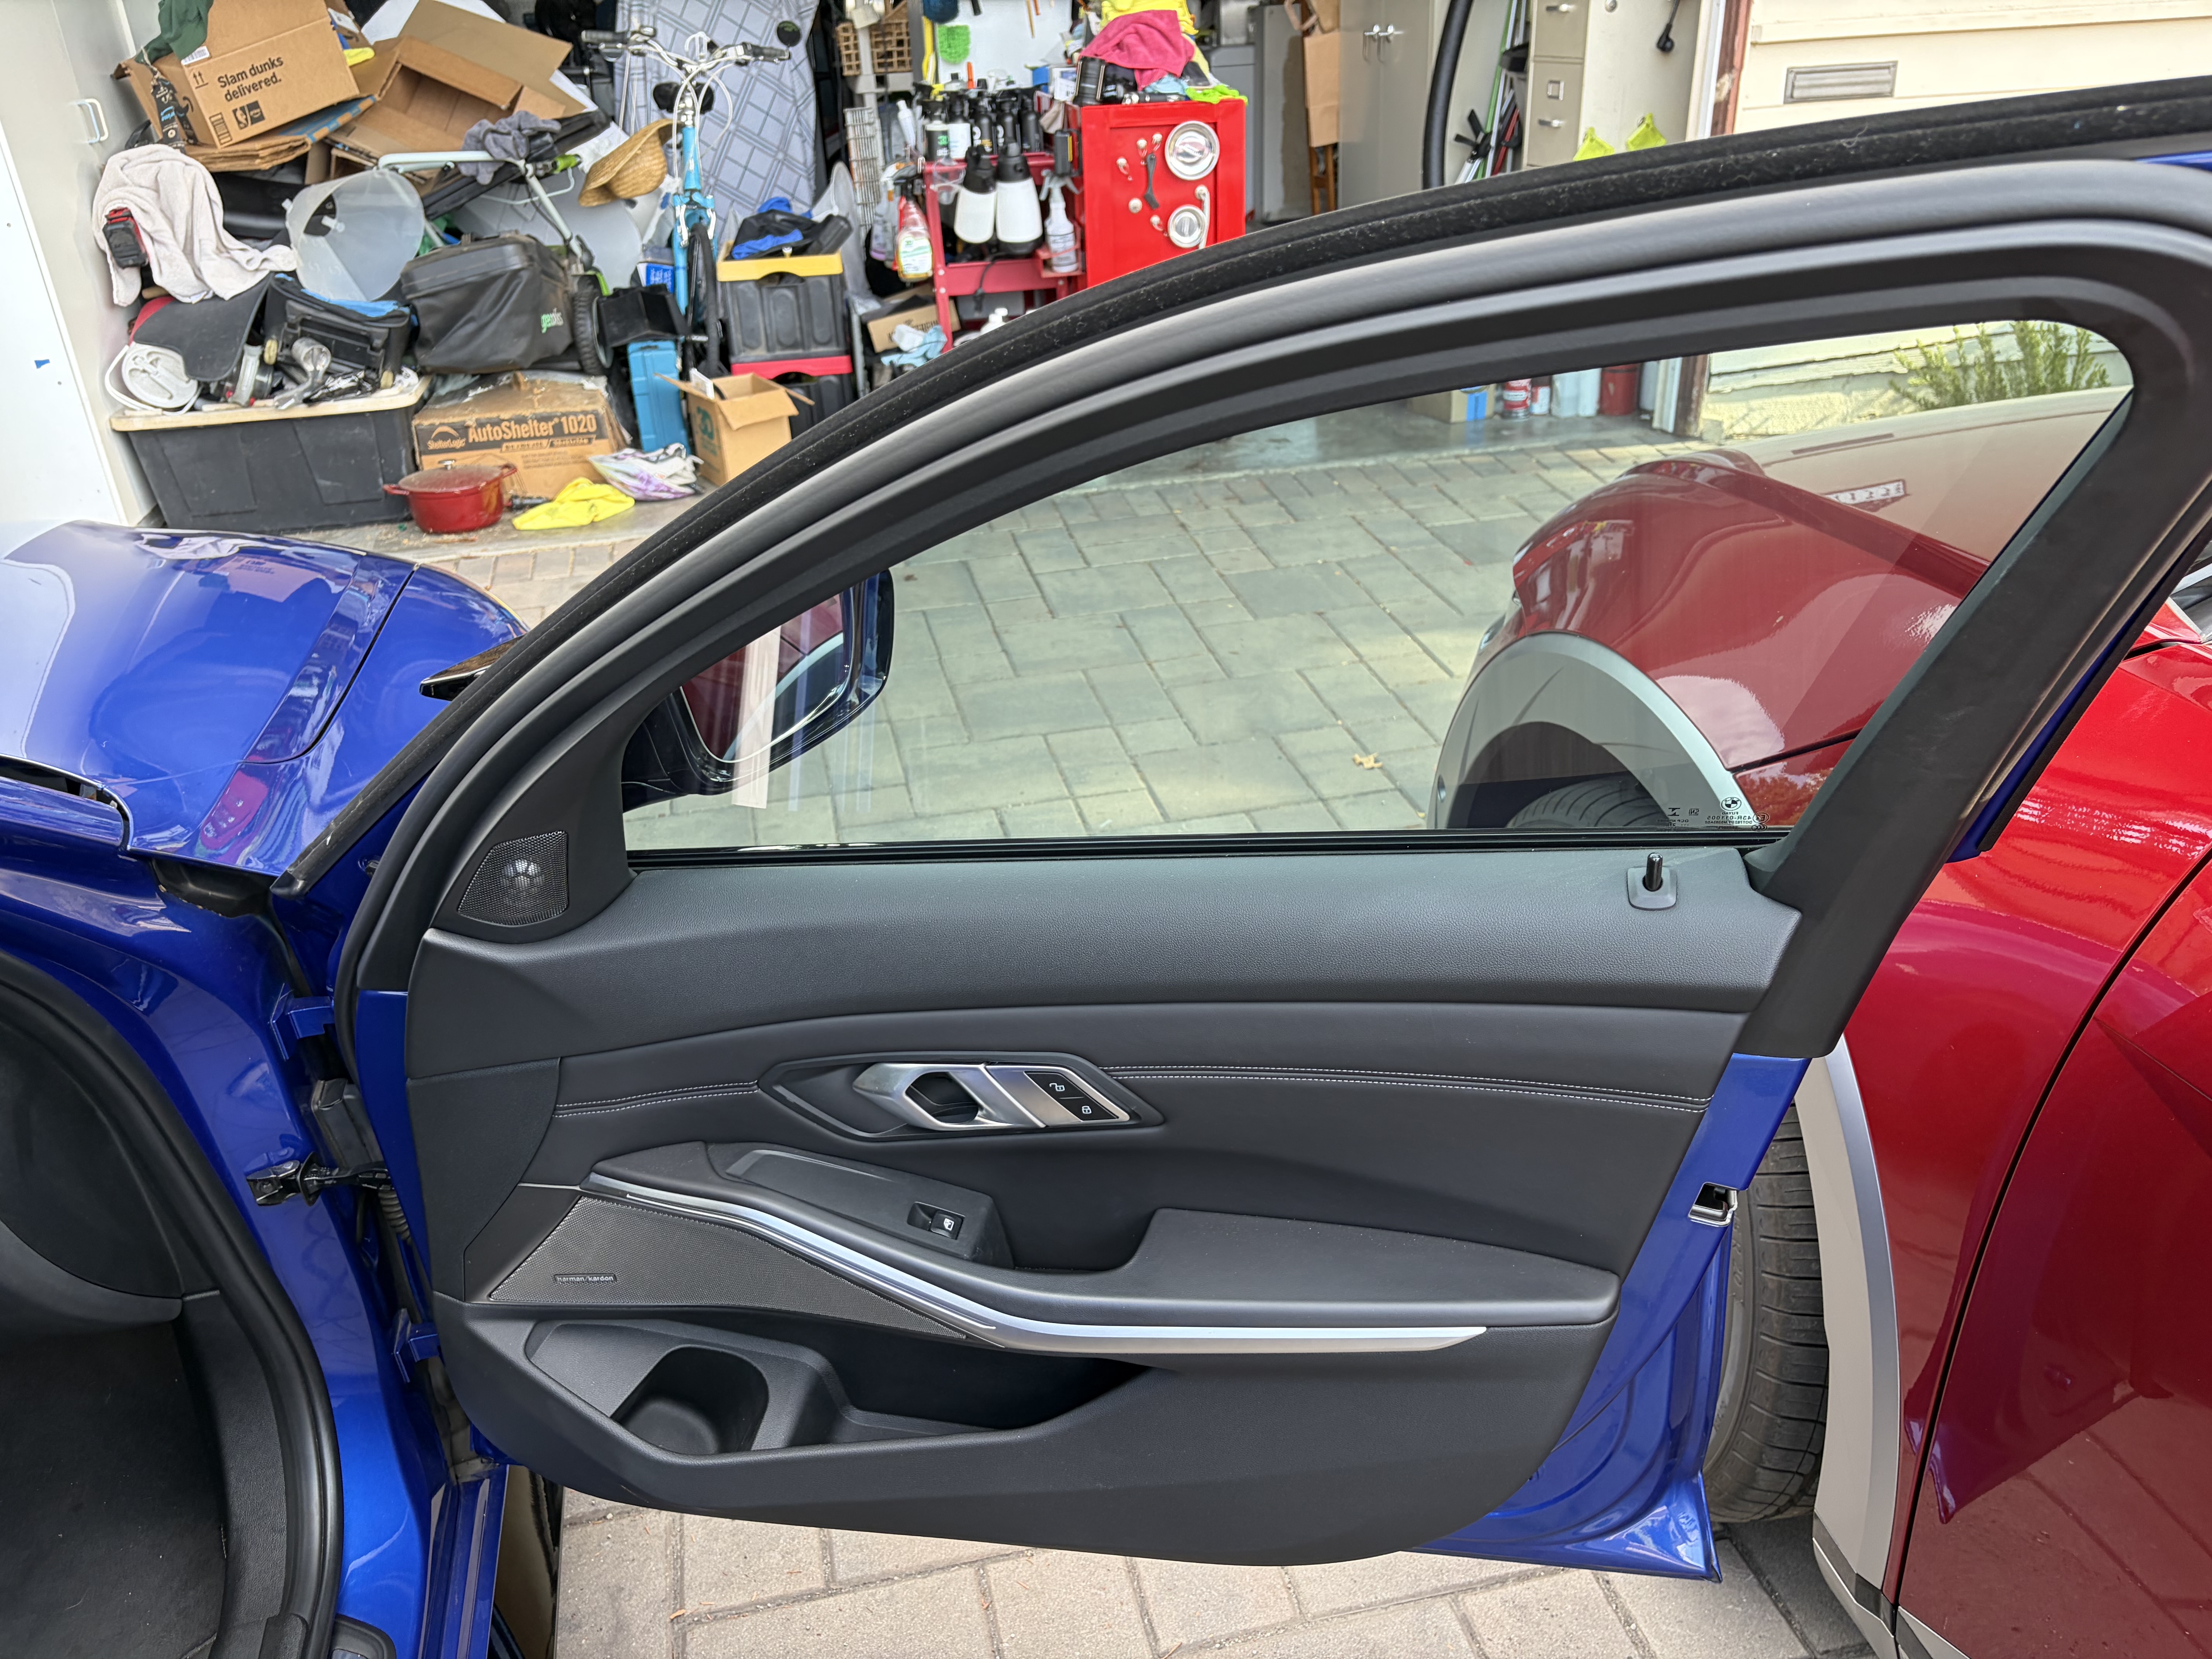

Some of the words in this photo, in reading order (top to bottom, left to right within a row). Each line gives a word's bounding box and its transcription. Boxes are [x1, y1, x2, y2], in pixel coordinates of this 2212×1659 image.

[218, 71, 248, 88] Slam
[249, 57, 283, 77] dunks
[224, 72, 282, 102] delivered.
[560, 414, 596, 434] 1020
